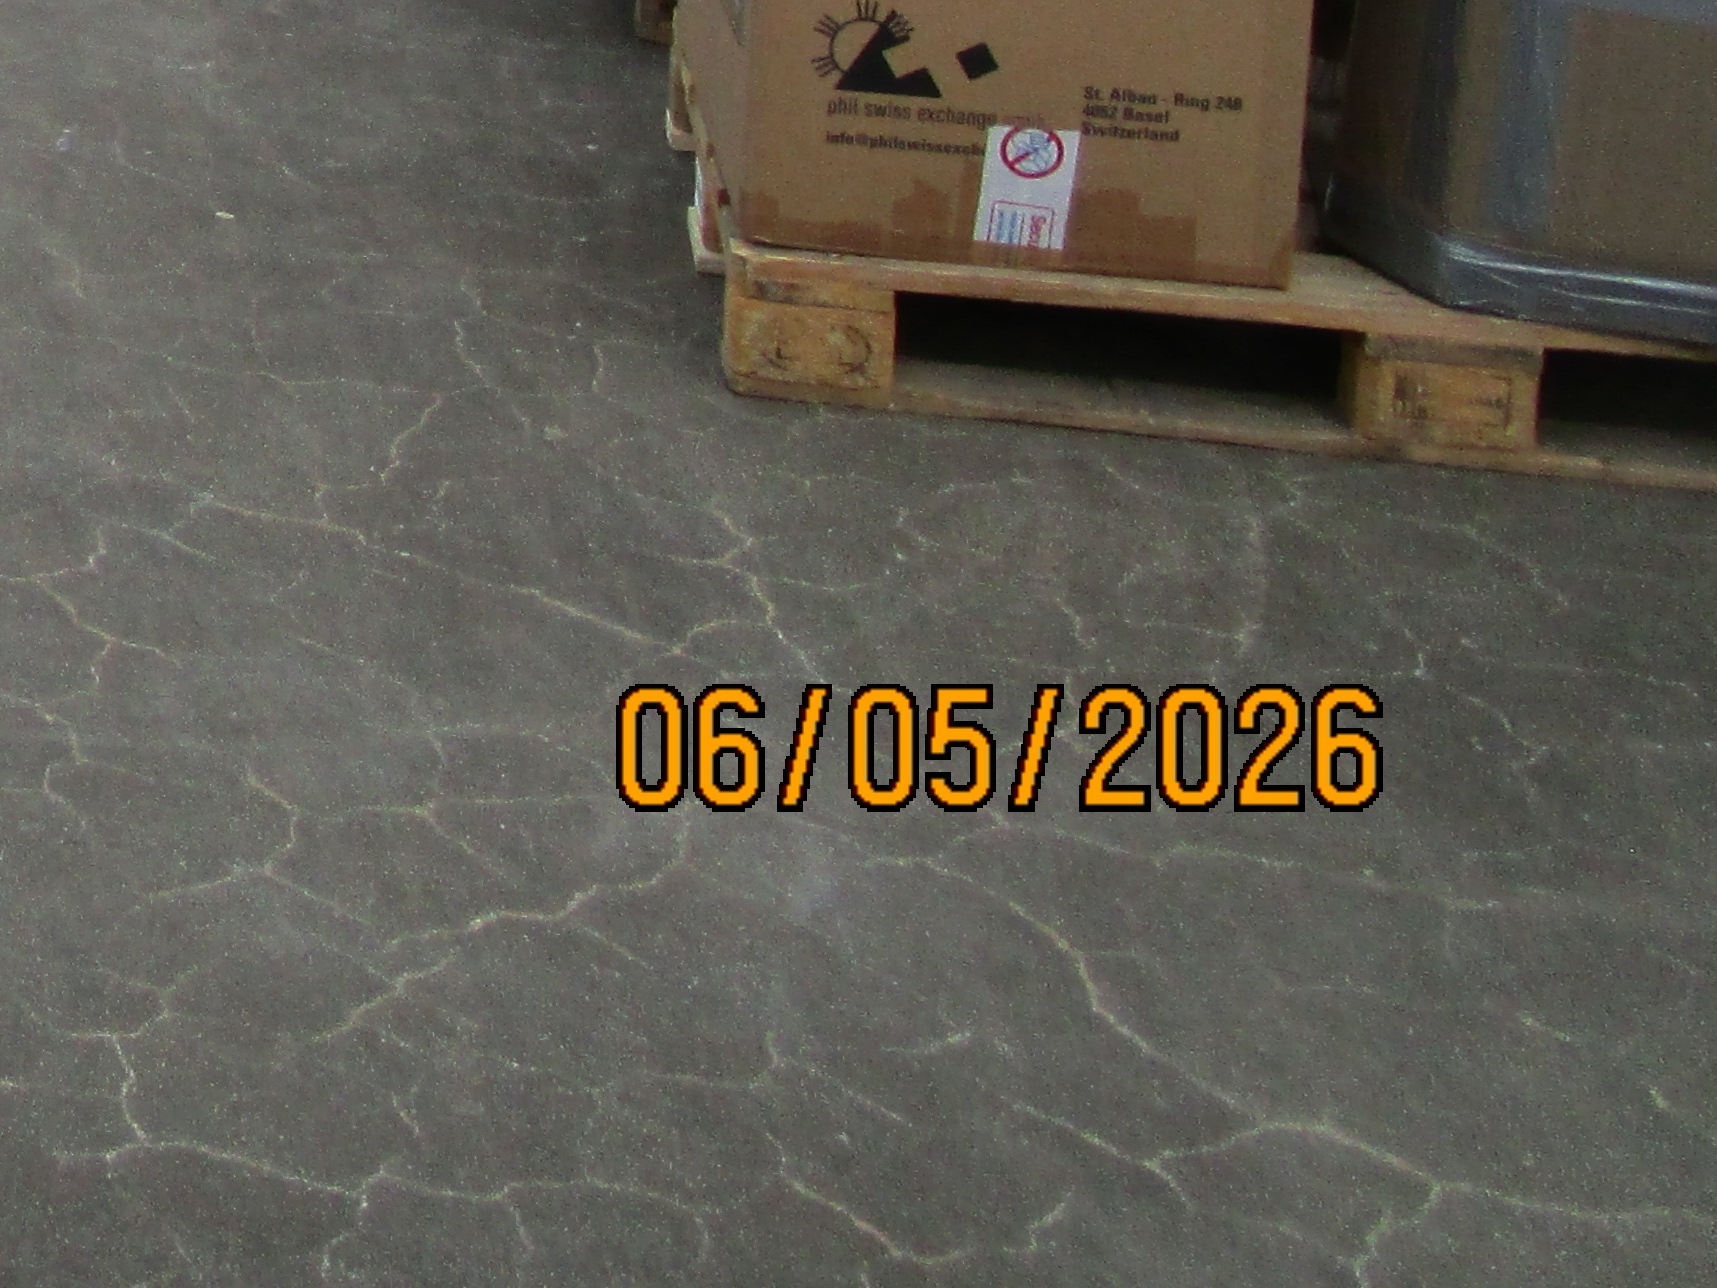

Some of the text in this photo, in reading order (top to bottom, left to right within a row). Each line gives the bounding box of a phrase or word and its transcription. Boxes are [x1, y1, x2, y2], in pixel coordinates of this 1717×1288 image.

[1173, 92, 1210, 112] Ring
[827, 97, 858, 119] phil
[863, 99, 913, 120] swiss
[917, 105, 998, 132] exchange
[1123, 107, 1170, 125] Basel
[1082, 123, 1181, 144] Switzerland
